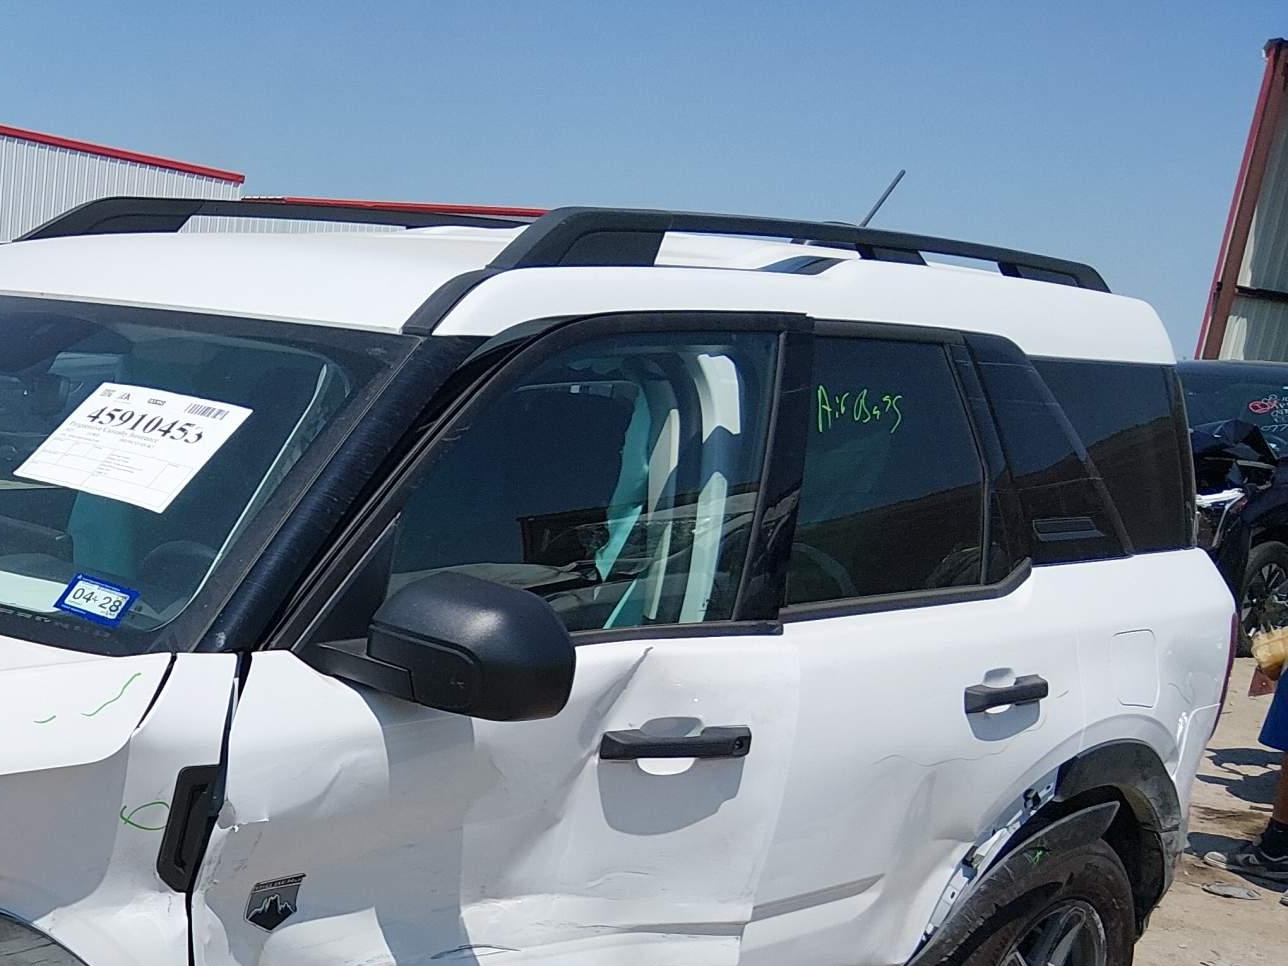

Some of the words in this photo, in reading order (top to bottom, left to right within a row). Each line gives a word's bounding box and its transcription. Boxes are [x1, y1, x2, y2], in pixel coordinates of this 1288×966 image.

[86, 405, 204, 445] 45910453
[72, 587, 95, 604] 04
[98, 596, 123, 613] 28
